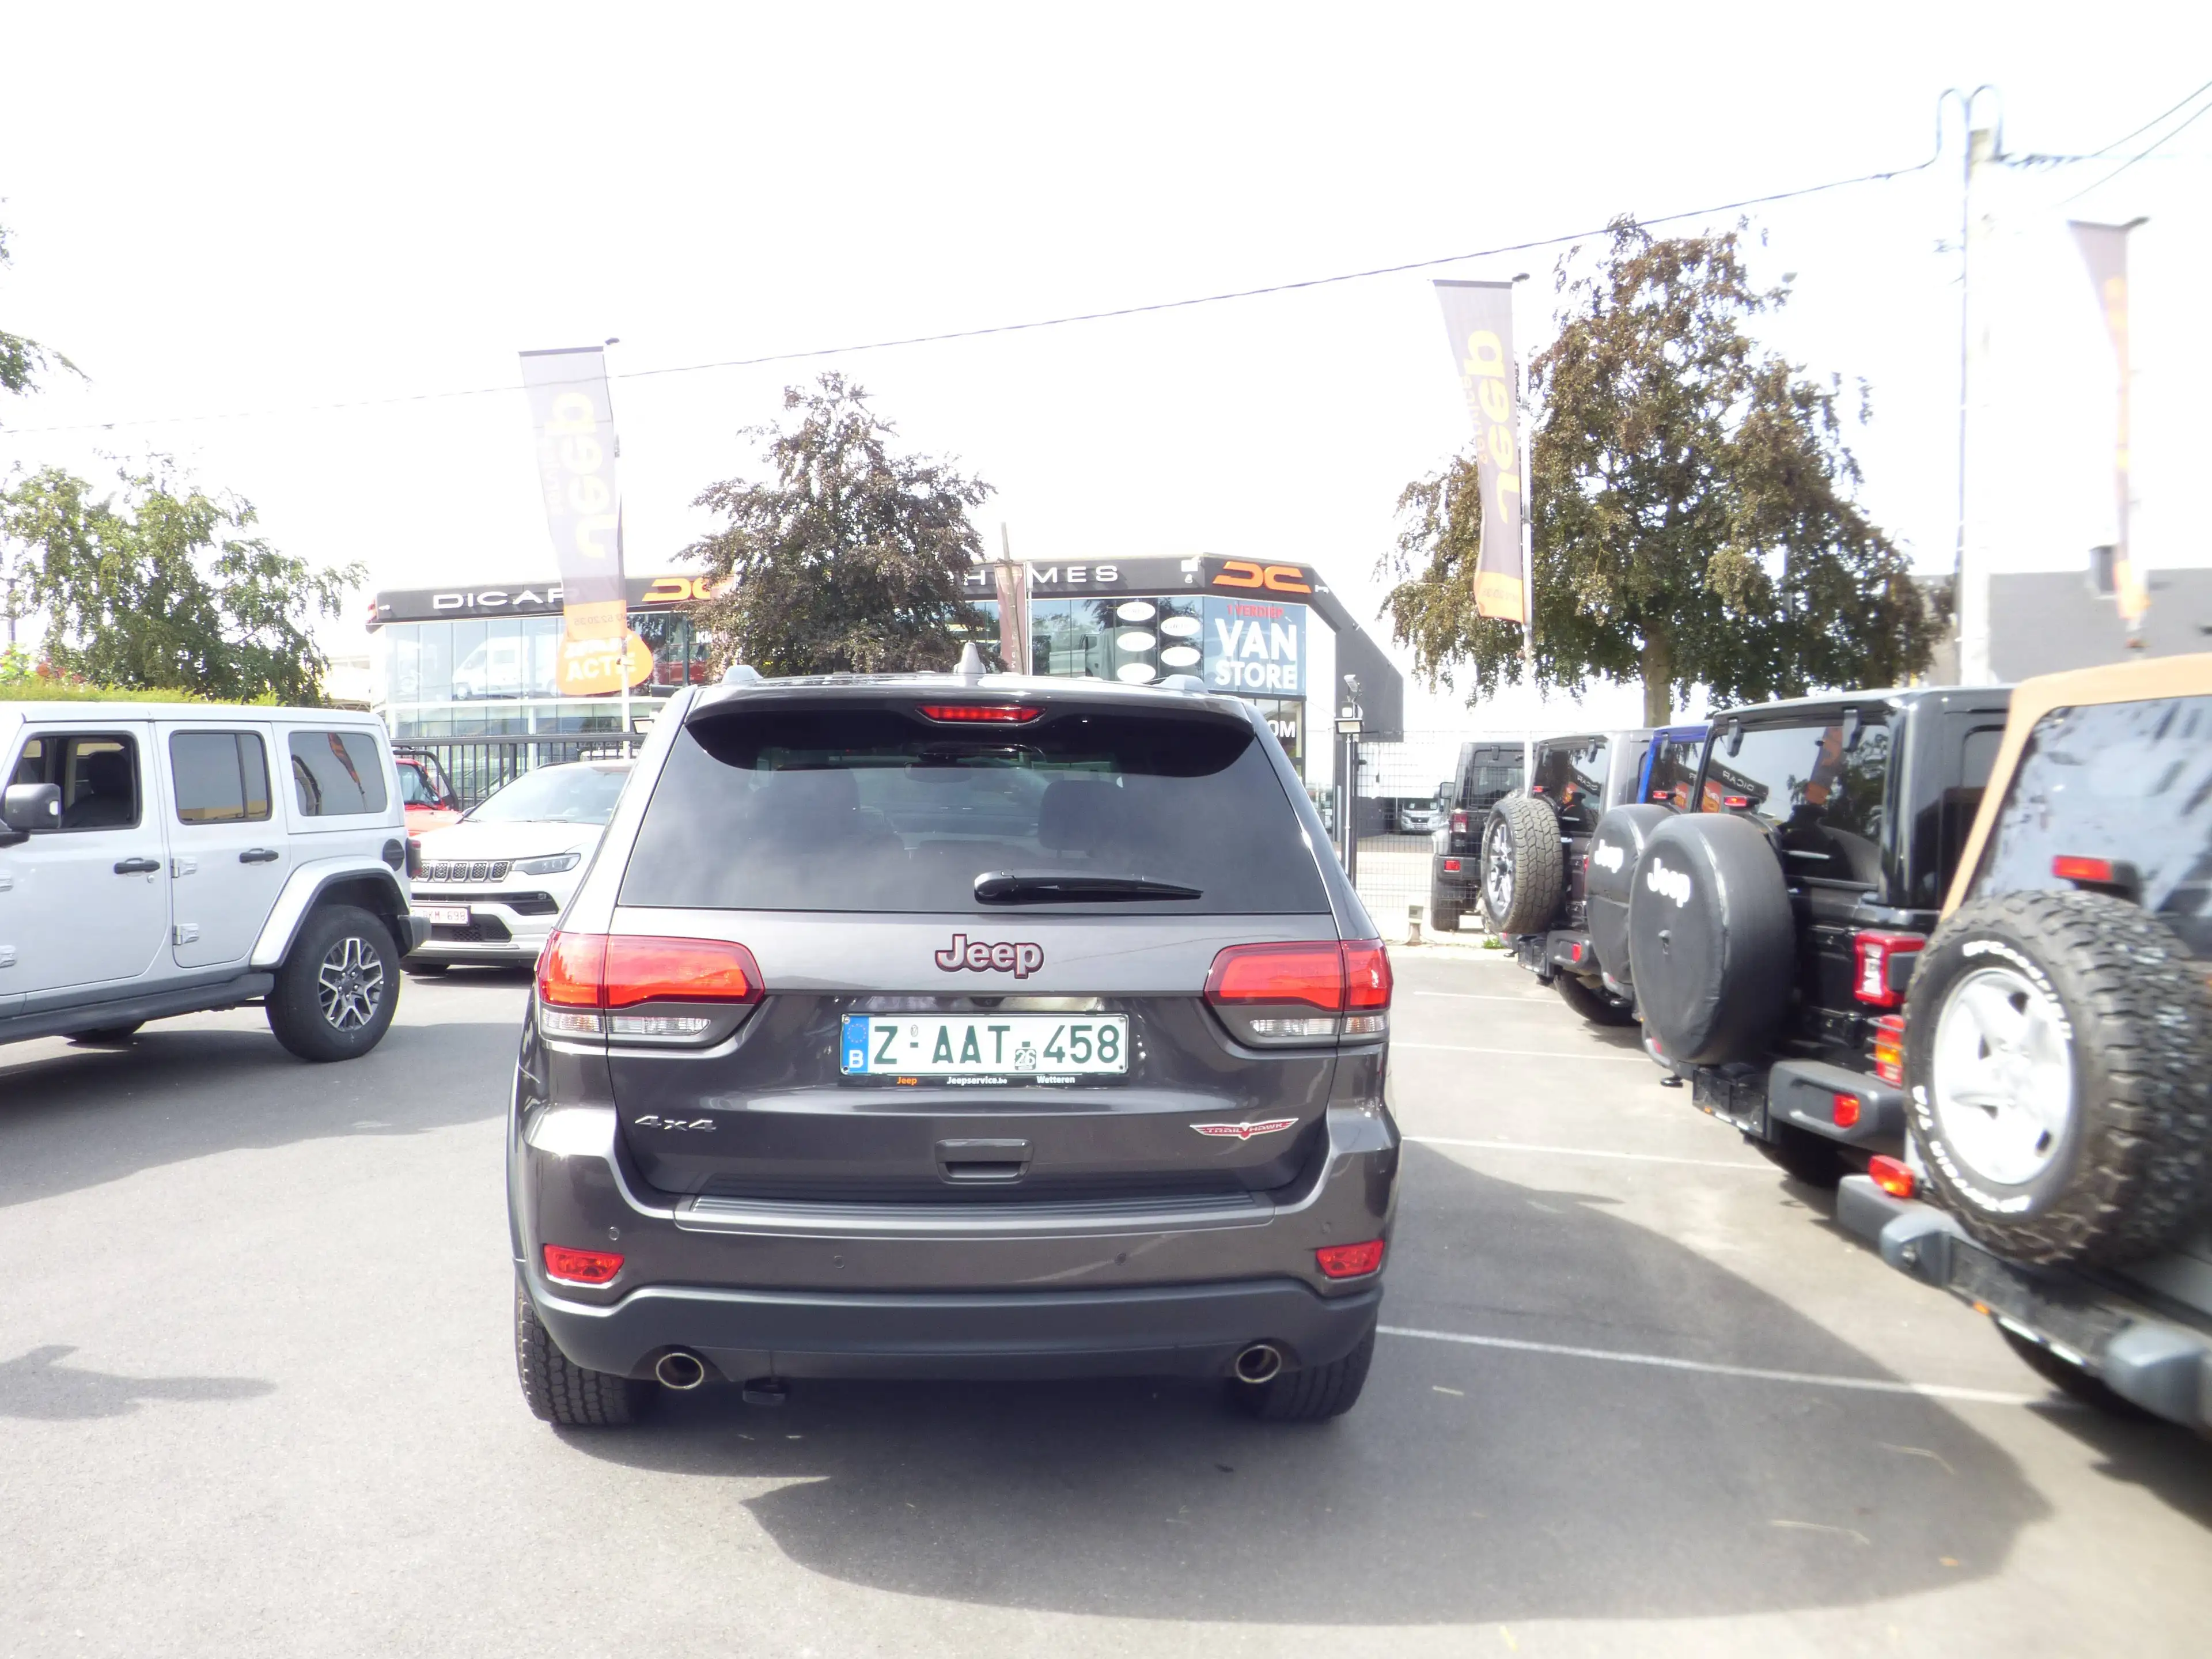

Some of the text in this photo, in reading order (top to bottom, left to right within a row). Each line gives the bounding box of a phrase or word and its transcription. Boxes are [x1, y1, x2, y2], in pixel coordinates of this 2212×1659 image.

[1236, 605, 1284, 619] VERDIEP
[1215, 618, 1297, 661] VAN
[1215, 659, 1297, 690] STORE
[935, 933, 1044, 979] Jeep
[849, 1050, 863, 1068] B
[1016, 1049, 1036, 1066] 26
[896, 1075, 1075, 1086] Jeep Jeepservice.be Wetteren
[635, 1115, 717, 1132] 4x4
